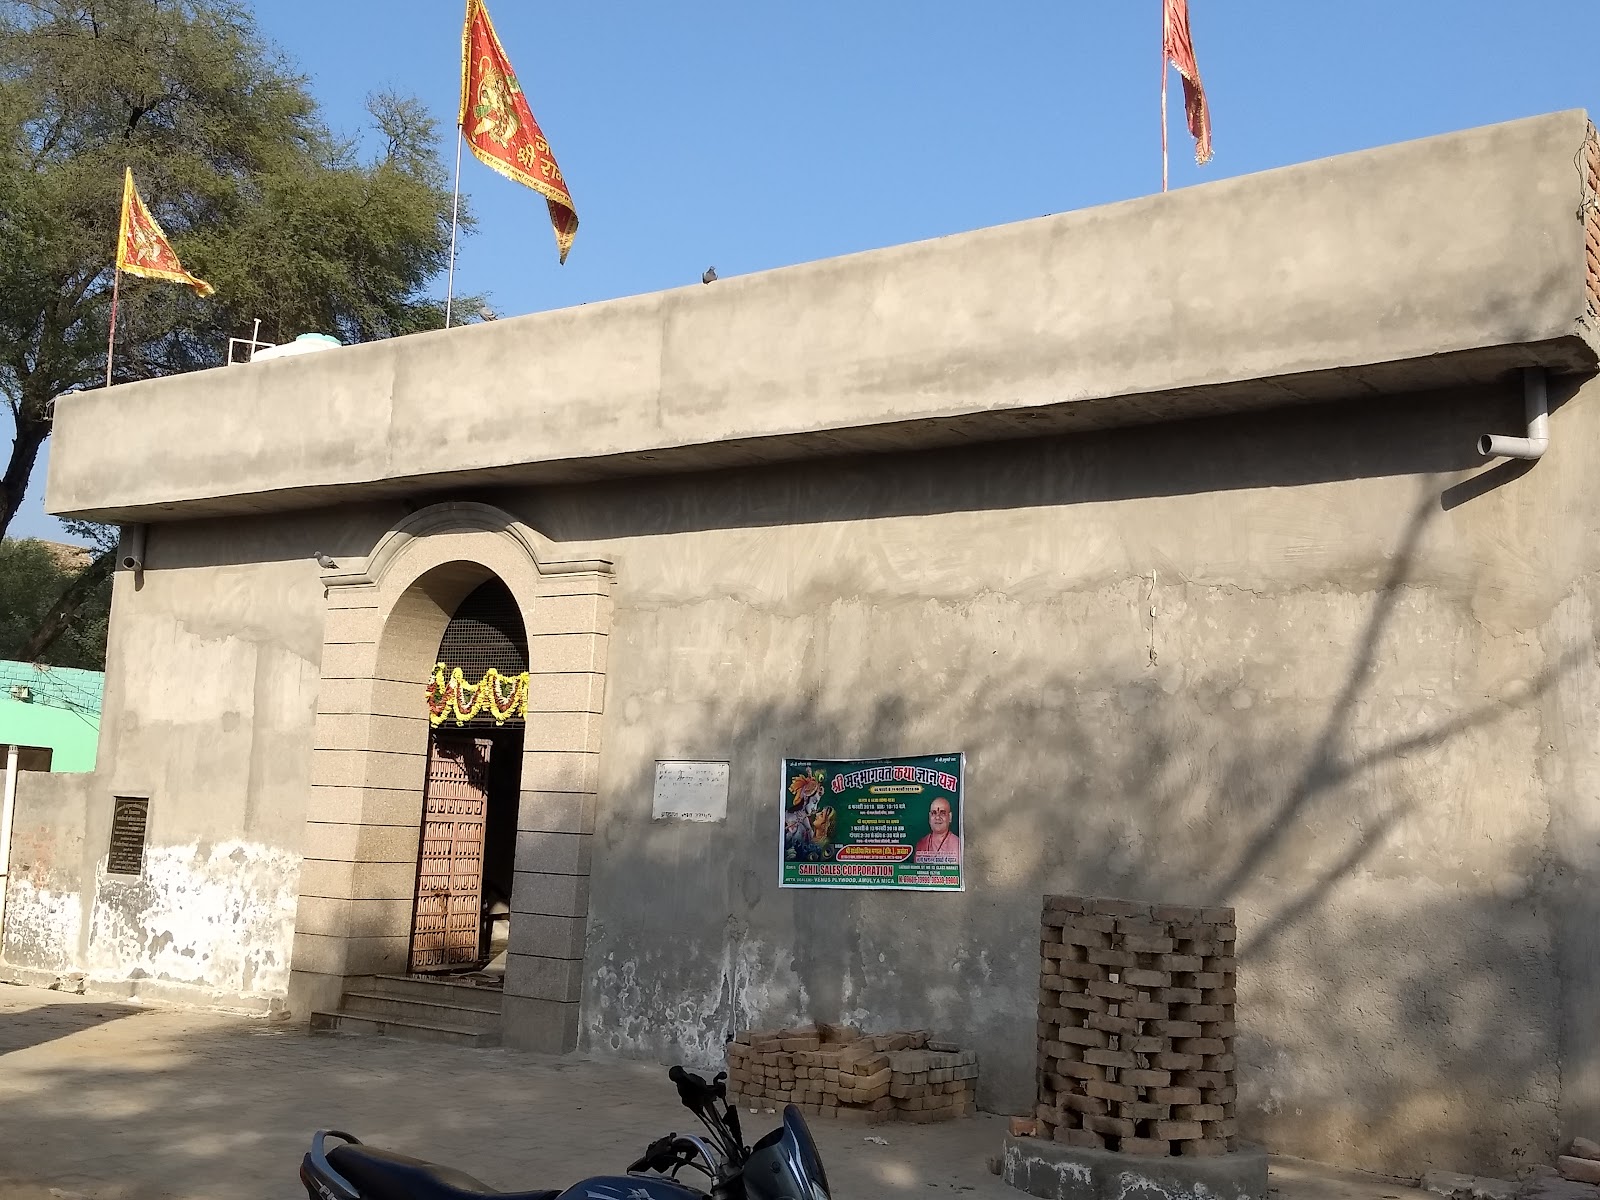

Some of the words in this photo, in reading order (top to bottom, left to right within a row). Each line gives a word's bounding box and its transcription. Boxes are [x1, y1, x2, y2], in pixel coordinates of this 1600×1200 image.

[517, 143, 536, 169] श्री
[831, 774, 845, 793] श्री
[893, 766, 916, 782] कथा
[916, 767, 938, 786] ज्ञान
[938, 772, 957, 792] यज्ञ
[799, 864, 819, 875] SAHIL
[820, 864, 841, 876] SALES
[842, 865, 893, 877] CORPORATION
